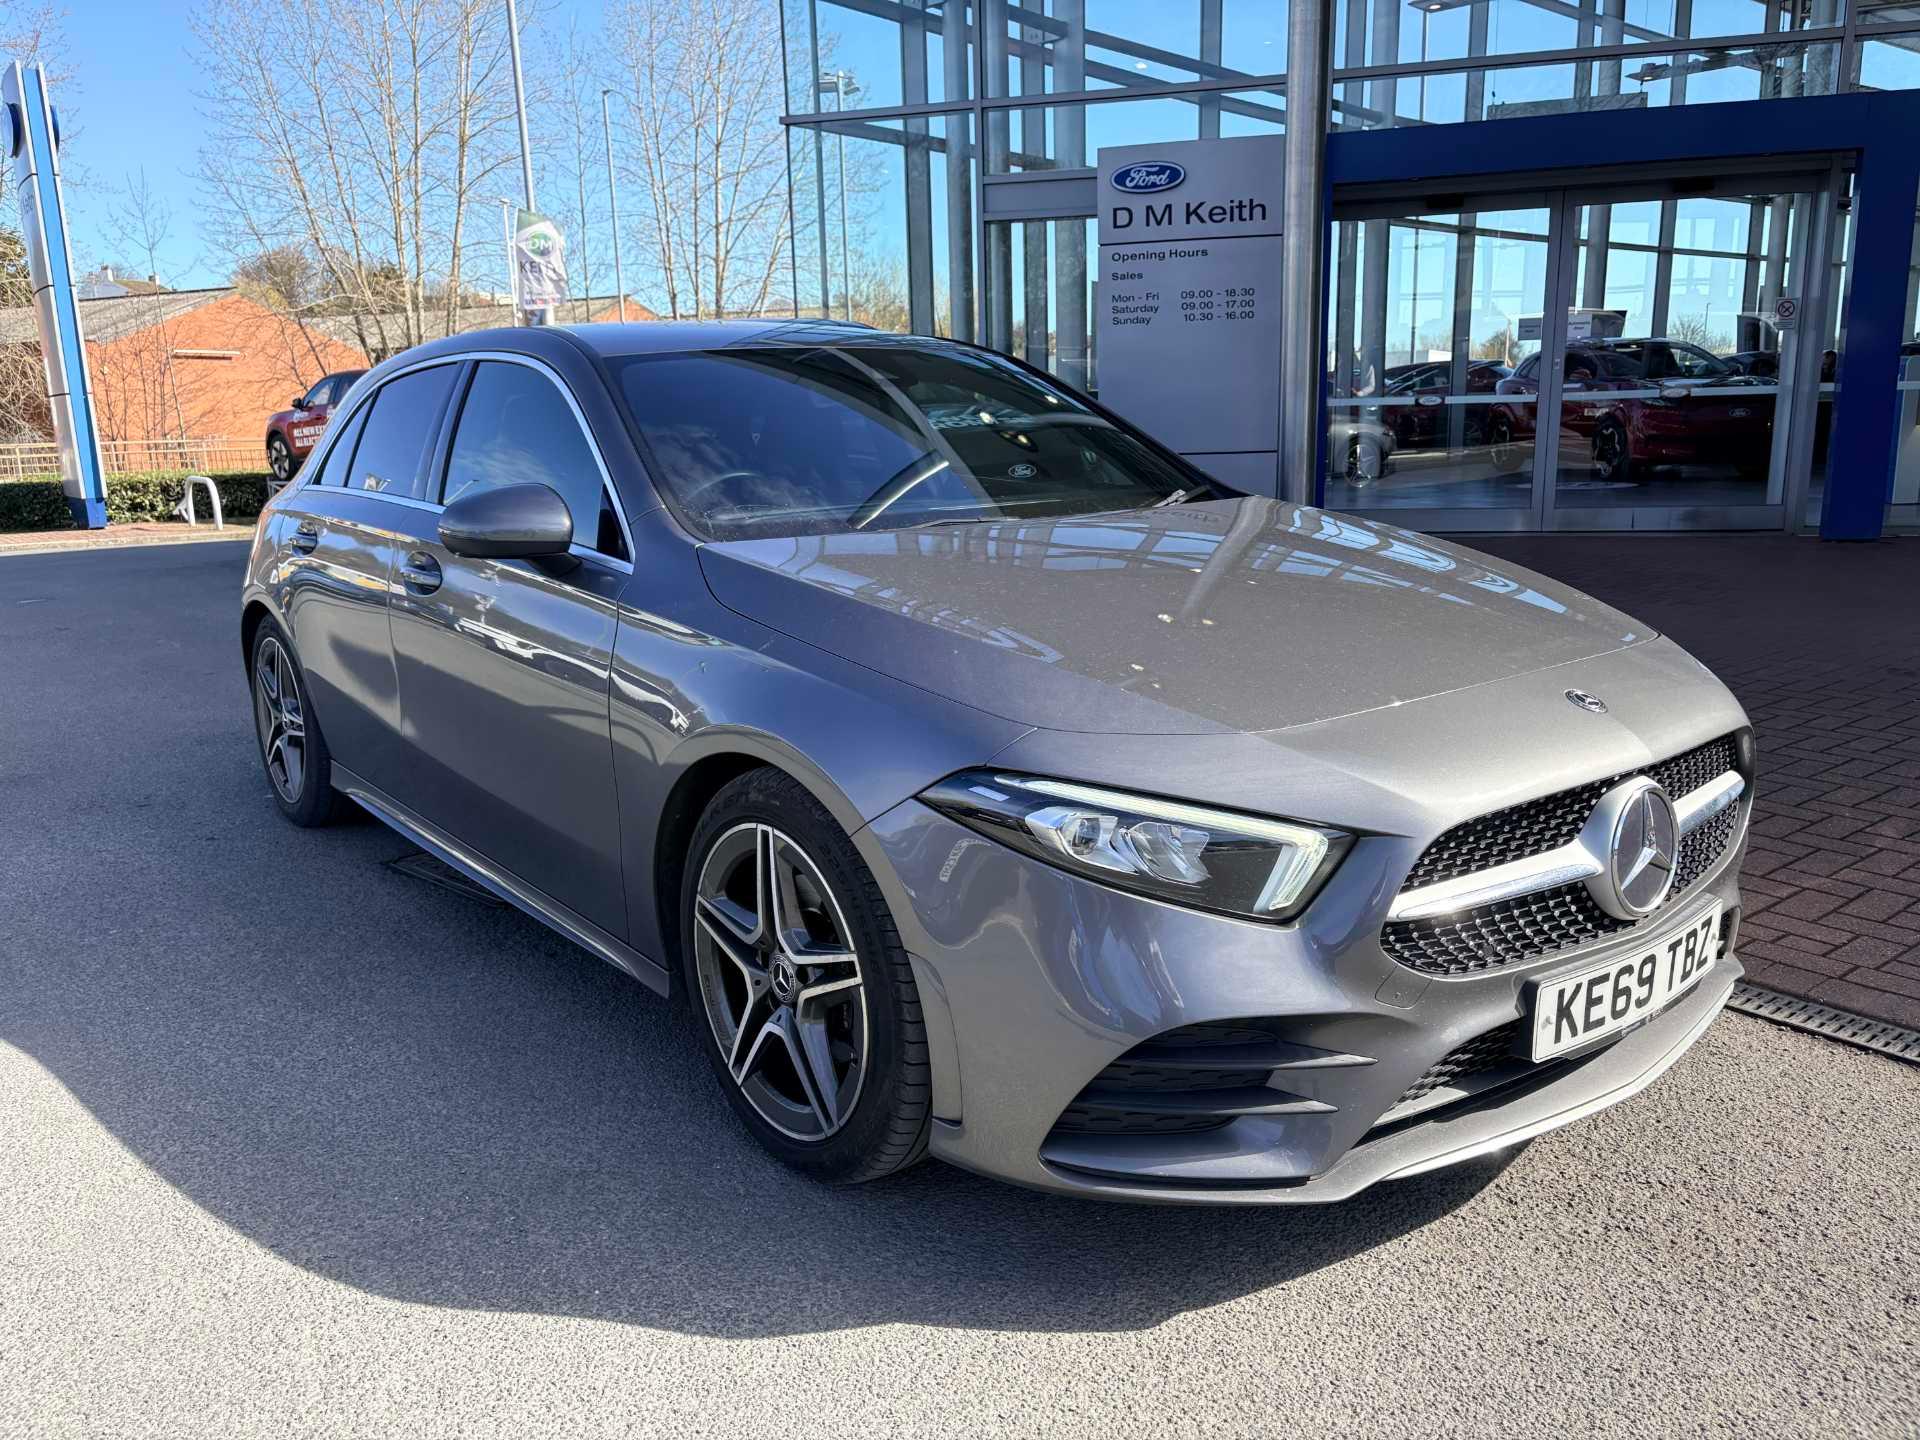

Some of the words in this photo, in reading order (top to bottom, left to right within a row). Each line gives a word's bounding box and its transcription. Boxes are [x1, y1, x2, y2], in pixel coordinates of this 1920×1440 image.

[1125, 166, 1171, 188] Ford
[1112, 206, 1134, 229] D
[1145, 203, 1173, 227] M
[1185, 198, 1267, 225] Keith
[529, 238, 554, 251] DM
[1111, 250, 1166, 263] Opening
[1169, 248, 1209, 258] Hours
[1111, 271, 1144, 281] Sales
[1112, 294, 1135, 303] Mon
[1145, 292, 1160, 301] Fri
[1180, 289, 1213, 300] 09.00
[1224, 287, 1255, 297] 18.30
[1112, 304, 1160, 314] Saturday
[1181, 300, 1214, 311] 09.00
[1225, 299, 1255, 309] 17.00
[1112, 315, 1152, 326] Sunday
[1184, 312, 1214, 322] 10.30
[1225, 310, 1255, 320] 16.00
[1554, 953, 1657, 1044] KE69
[1667, 915, 1713, 992] TBZ
